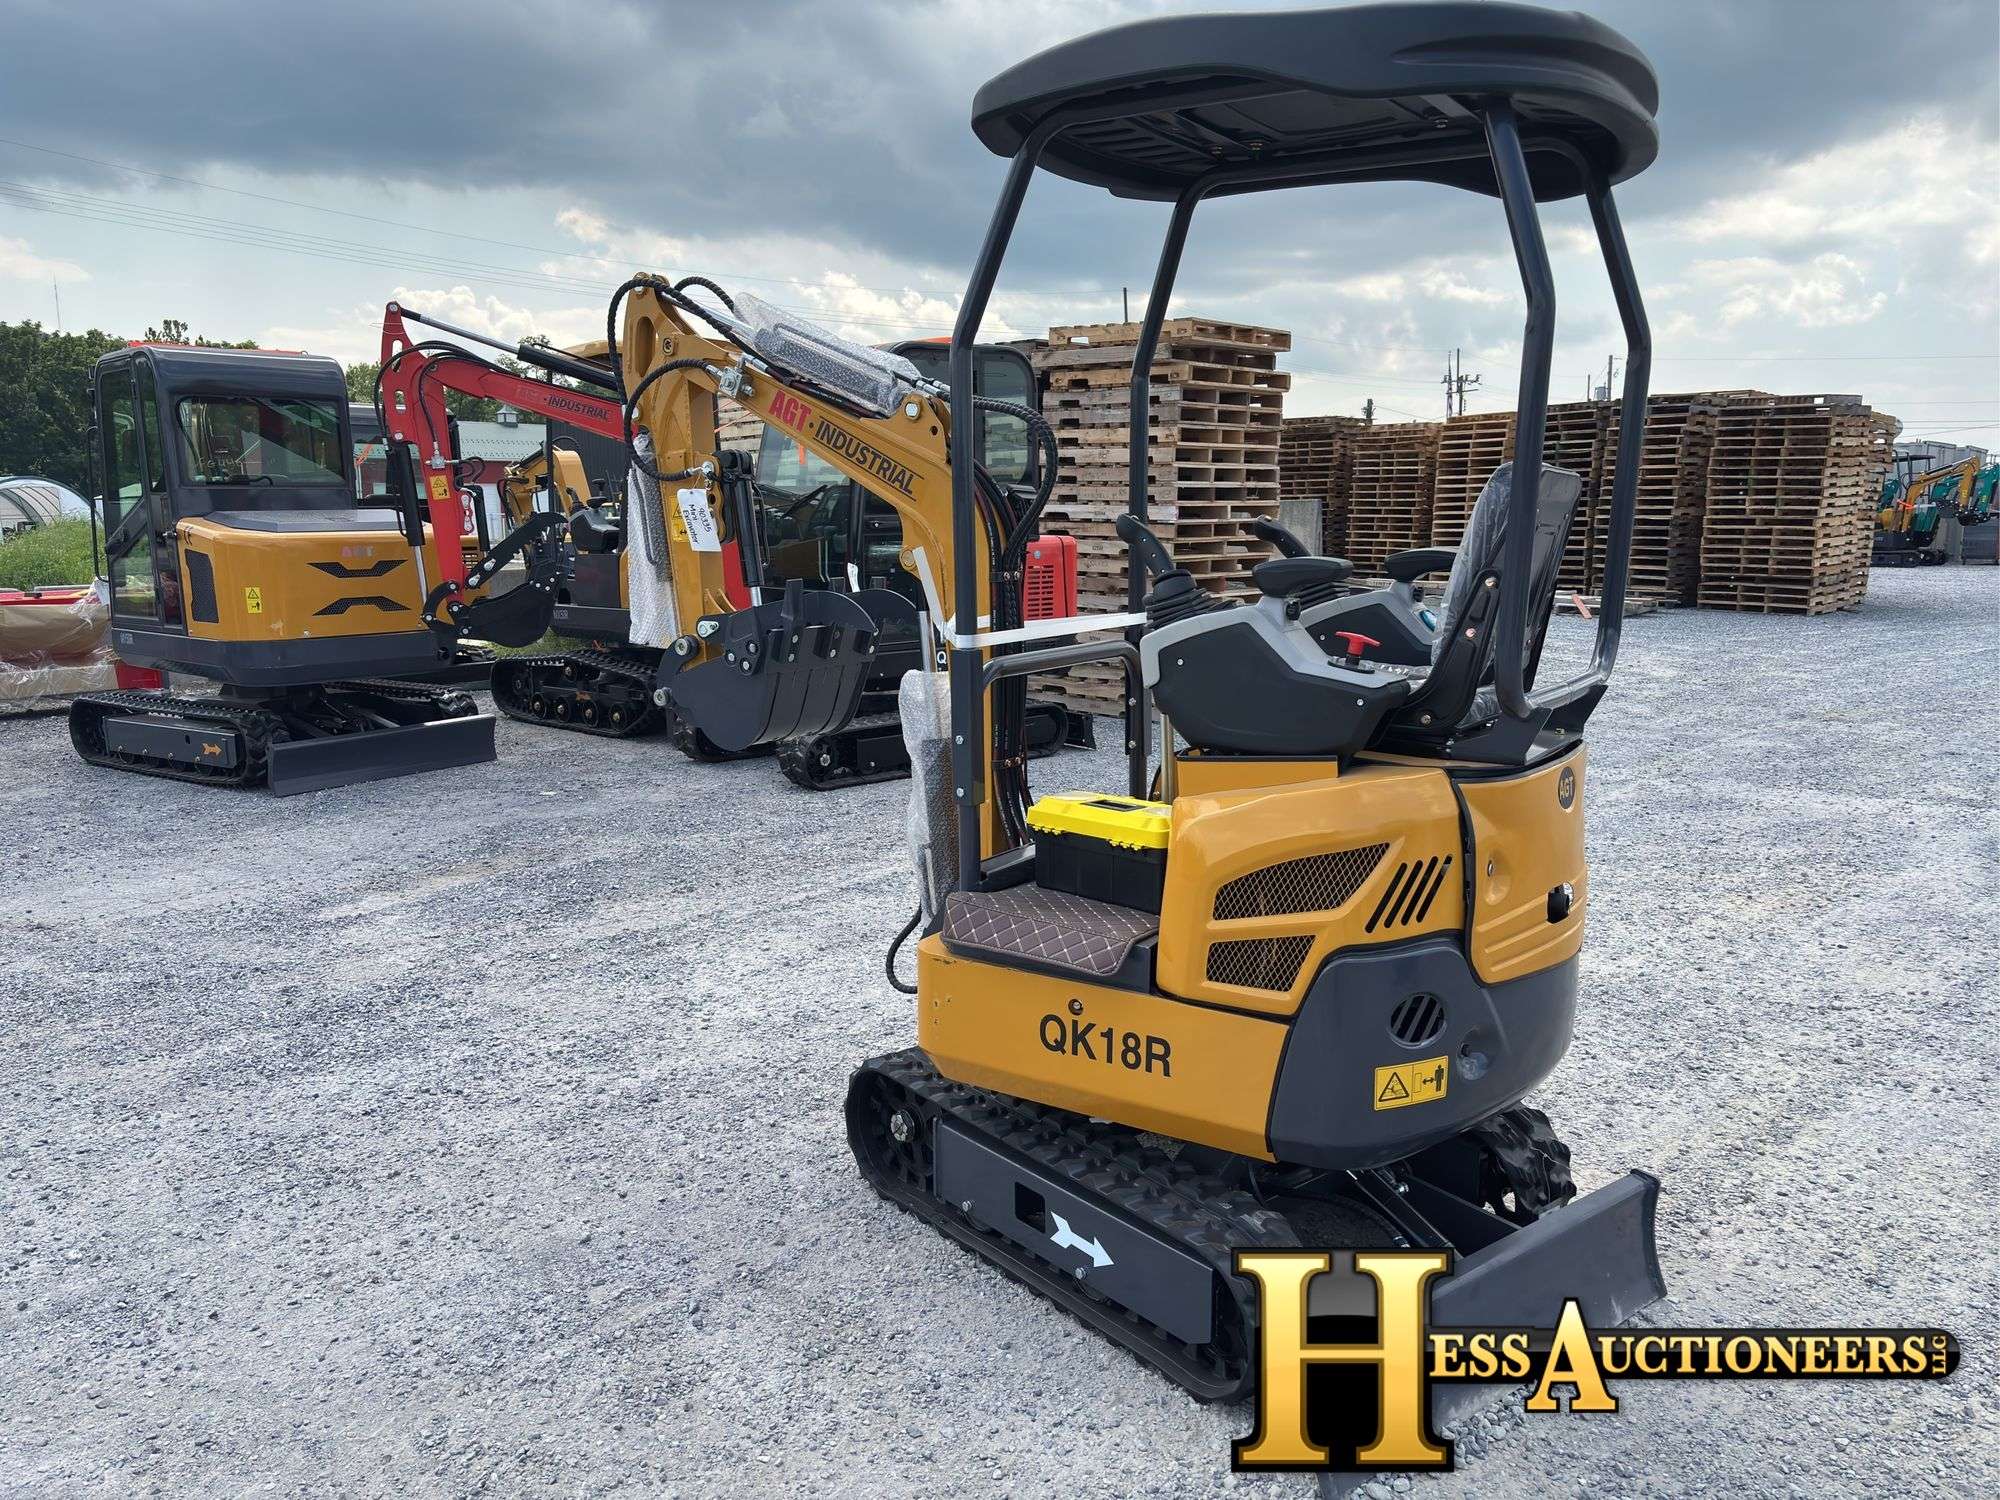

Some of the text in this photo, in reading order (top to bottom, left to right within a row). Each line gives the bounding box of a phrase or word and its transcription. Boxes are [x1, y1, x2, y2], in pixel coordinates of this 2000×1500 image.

[548, 395, 609, 420] INDUSTRIAL
[769, 389, 916, 494] AGT INDUSTRIAL
[1560, 777, 1573, 799] AGT
[1040, 1014, 1171, 1077] QK18R
